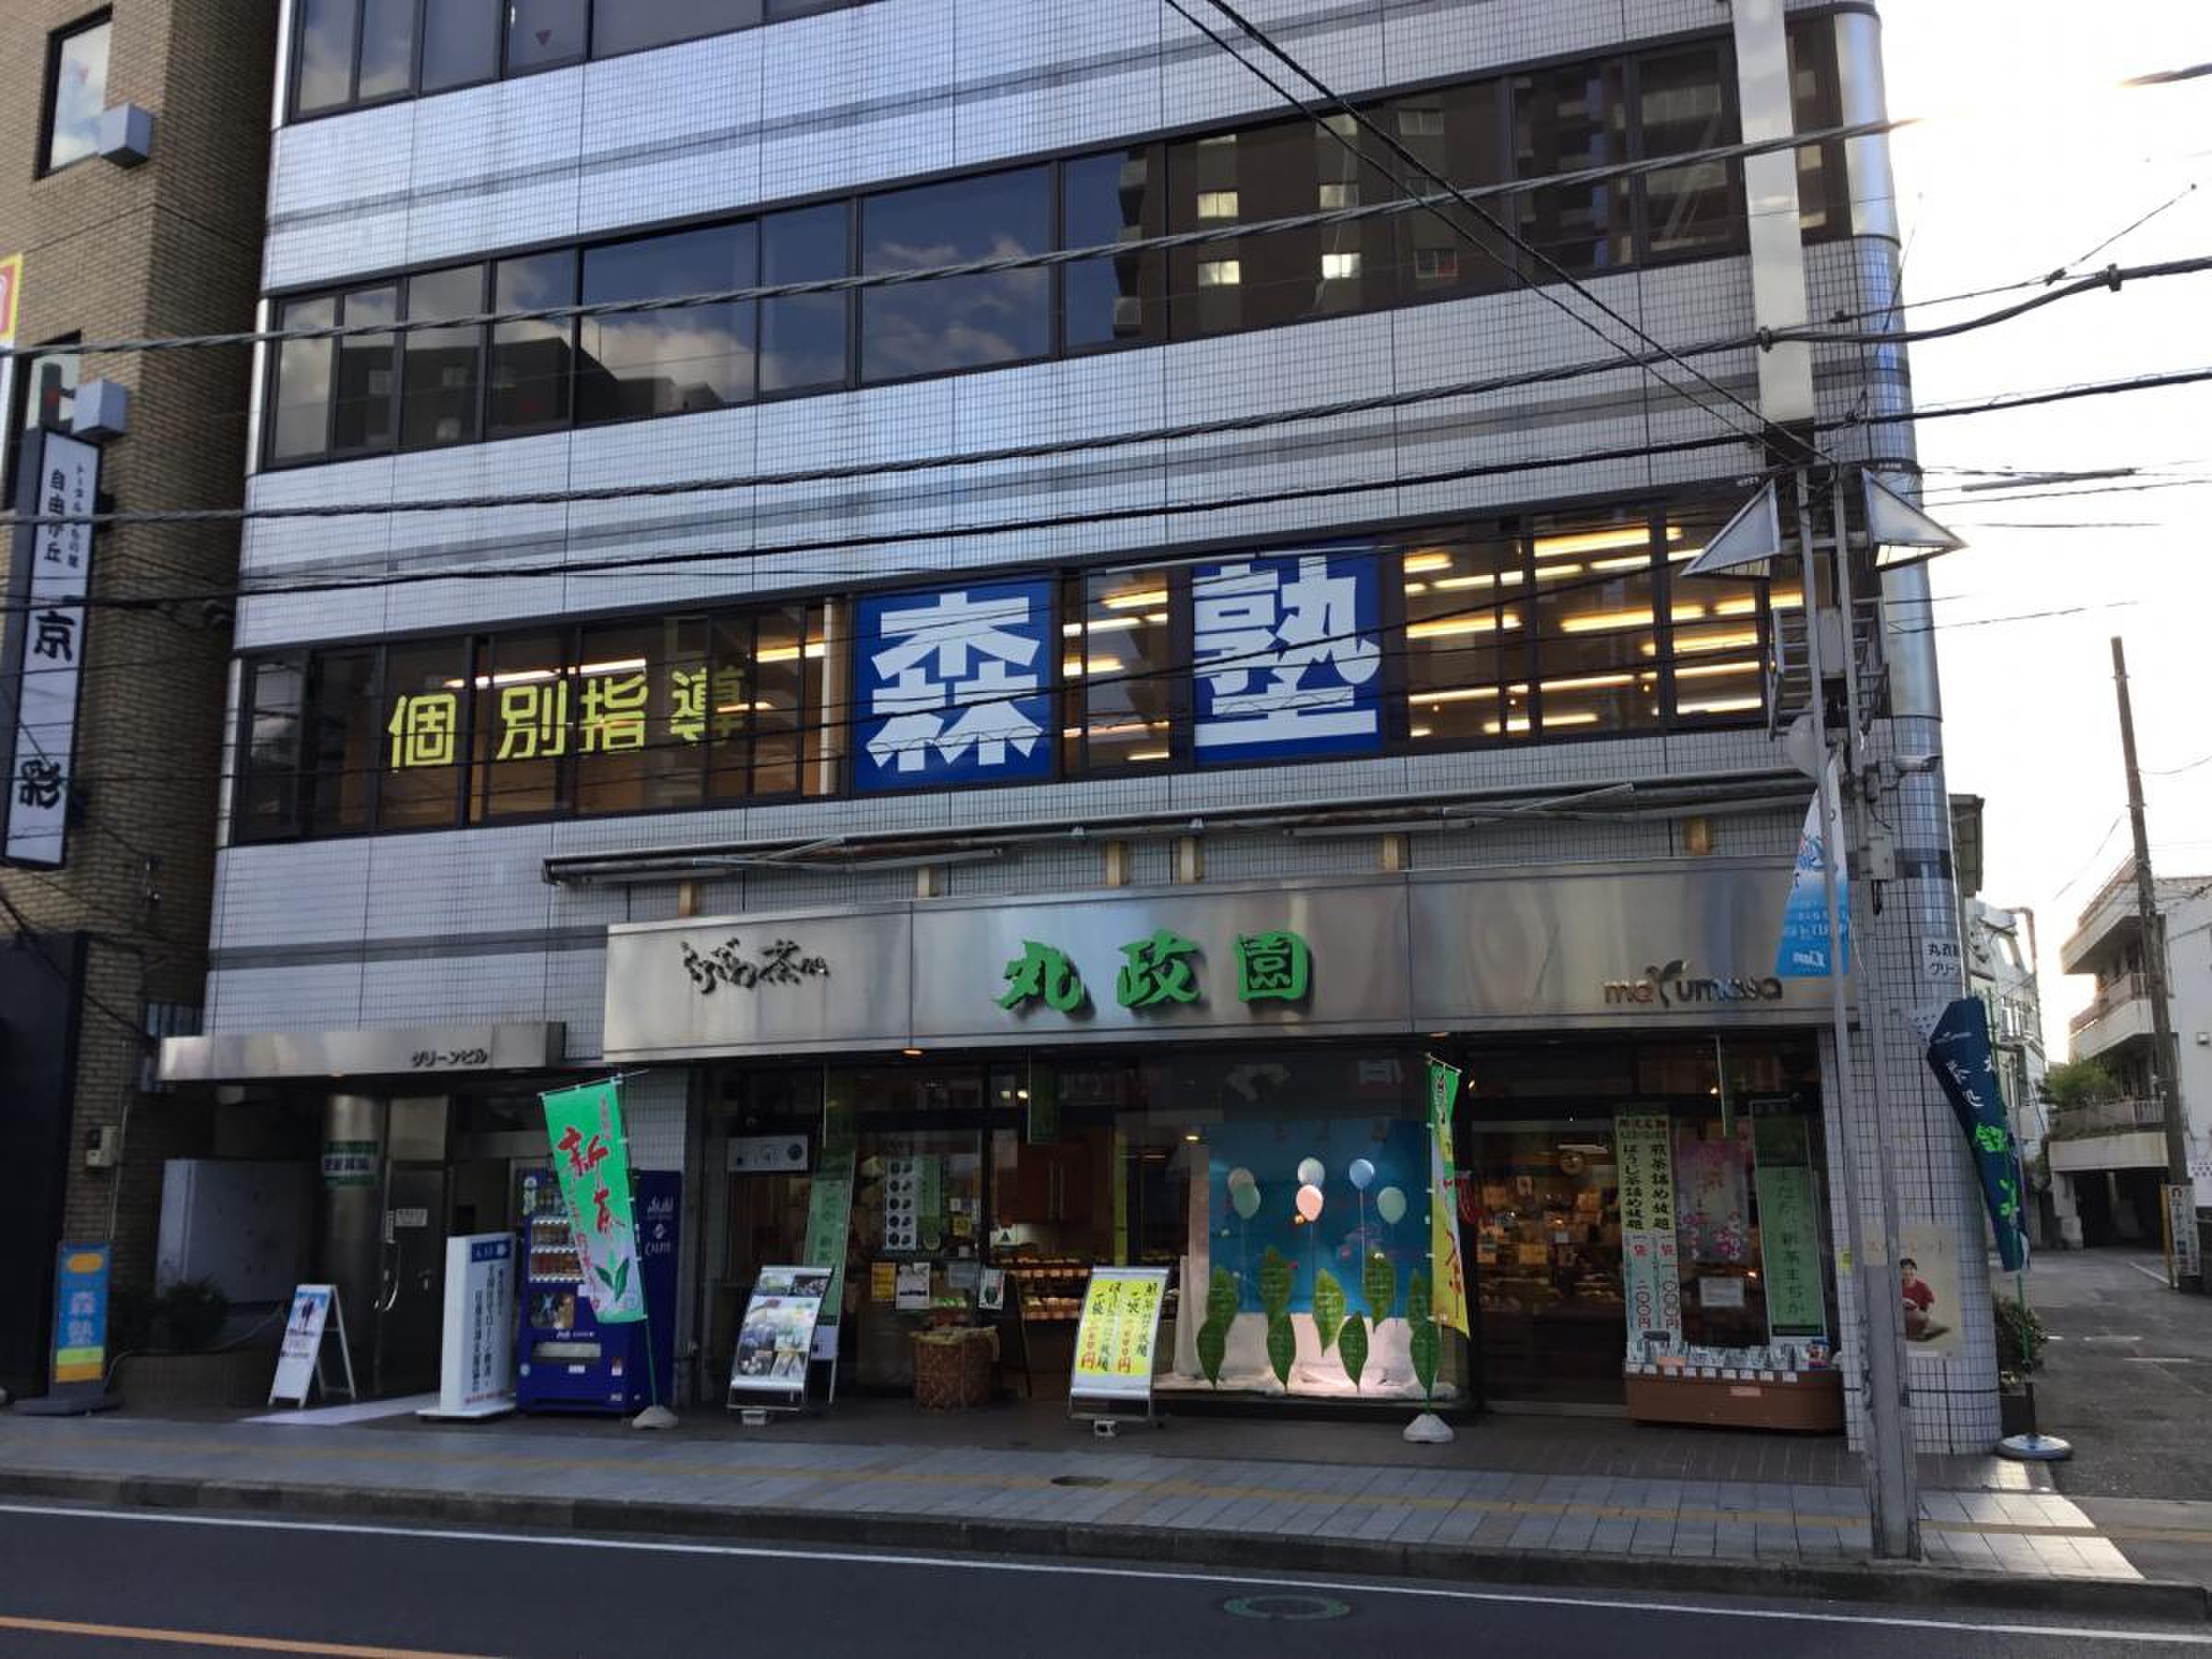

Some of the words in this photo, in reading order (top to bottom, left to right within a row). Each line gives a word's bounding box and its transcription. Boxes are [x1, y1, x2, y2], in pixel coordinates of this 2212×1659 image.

[866, 555, 1381, 772] 森塾
[387, 665, 745, 772] 個別指導
[992, 928, 1312, 1014] 丸政園
[411, 1048, 488, 1068] グリーンビル
[558, 1125, 625, 1232] 新茶
